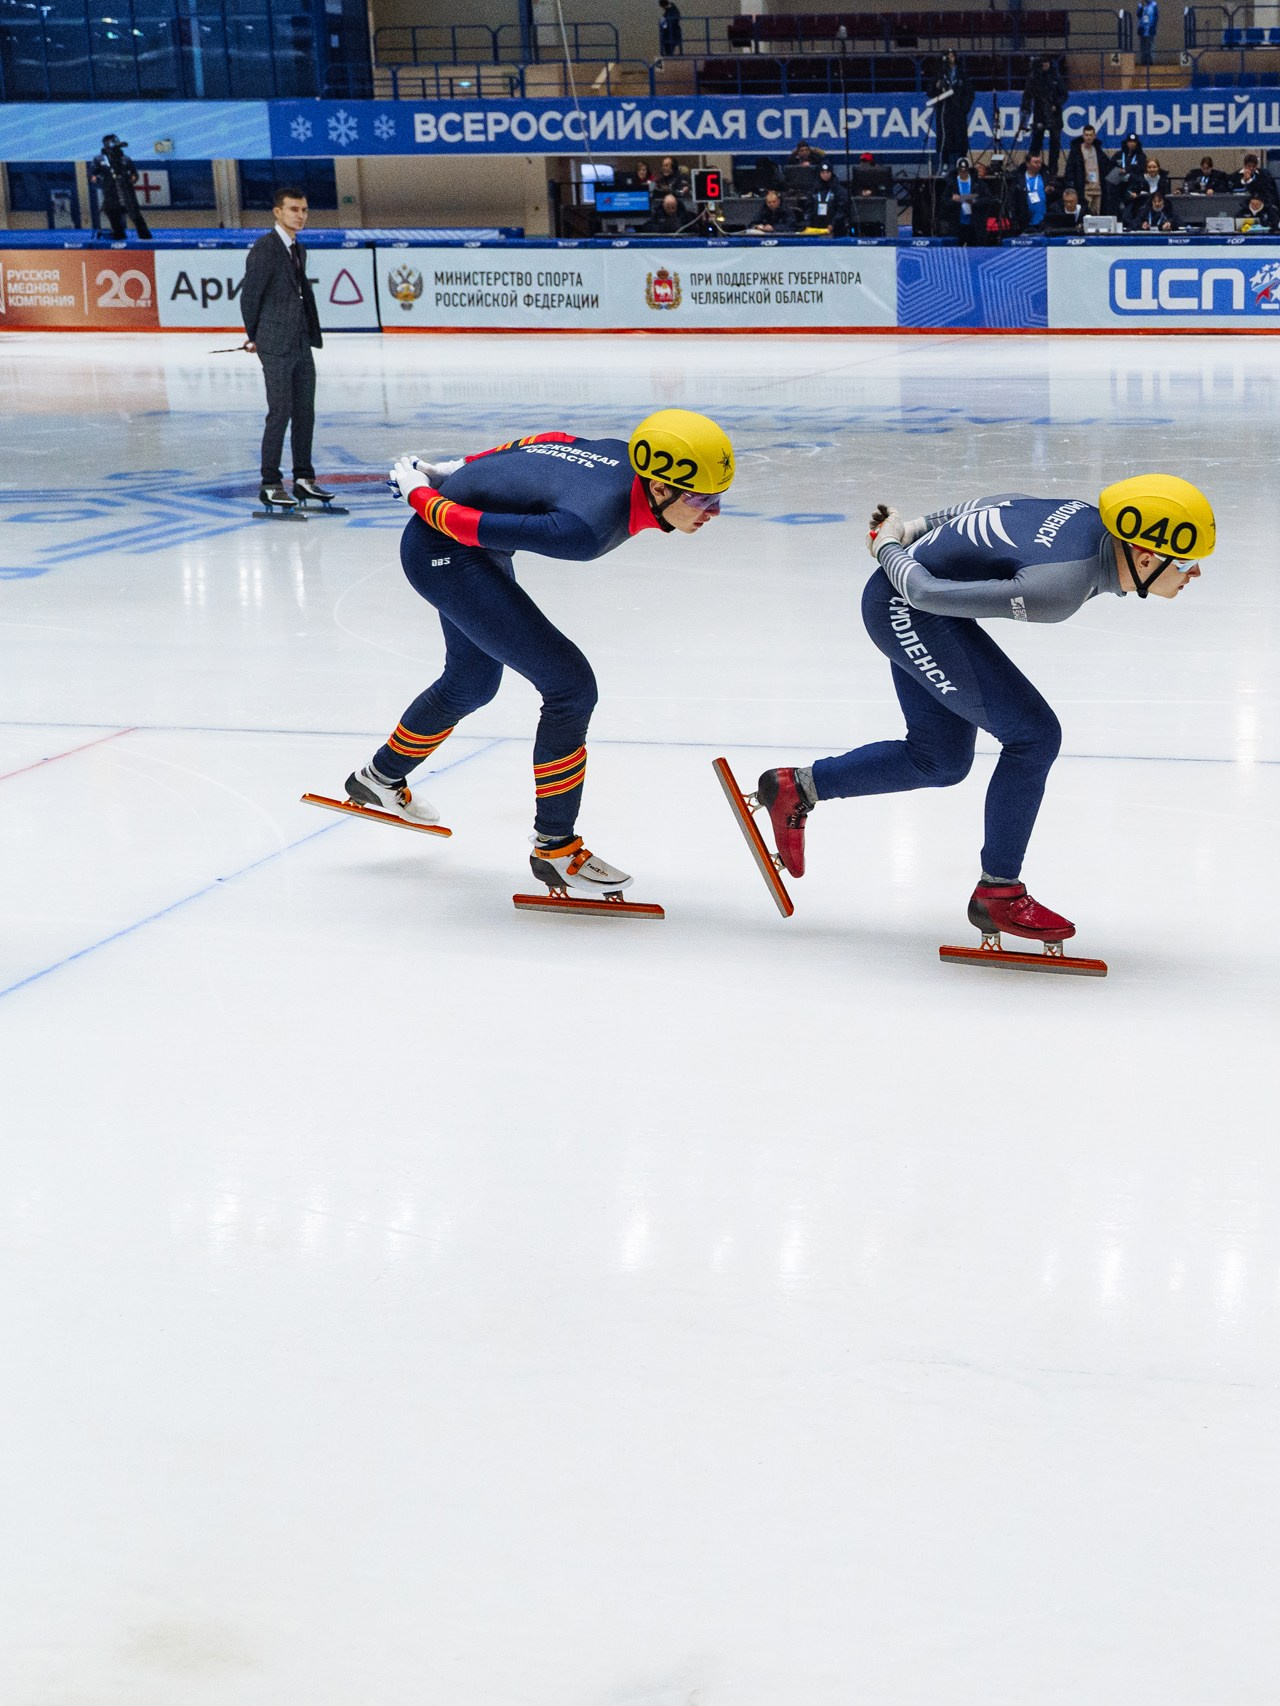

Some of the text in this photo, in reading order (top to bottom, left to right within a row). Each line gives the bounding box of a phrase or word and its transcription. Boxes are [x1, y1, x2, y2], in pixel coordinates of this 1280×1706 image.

[1111, 52, 1119, 64] 4
[1182, 52, 1190, 65] 3
[414, 103, 746, 143] ВСЕРОССИЙСКАЯ
[706, 173, 720, 198] 6
[7, 269, 60, 281] РУССКАЯ
[434, 271, 583, 287] МИНИСТЕРСТВО СПОРТА
[690, 271, 862, 287] ПРИ ПОДДЕРЖКЕ ГУБЕРНАТОРА
[7, 282, 60, 294] МЕДНАЯ
[96, 269, 151, 307] 20
[690, 288, 824, 305] ЧЕЛЯБИНСКОЙ ОБЛАСТИ
[1114, 268, 1245, 310] ЦСП
[8, 295, 75, 307] КОМПАНИЯ
[434, 290, 599, 310] РОССИЙСКОЙ ФЕДЕРАЦИИ
[633, 438, 699, 489] 022
[1115, 505, 1198, 555] 040
[889, 596, 958, 695] СМОЛЕНСК
